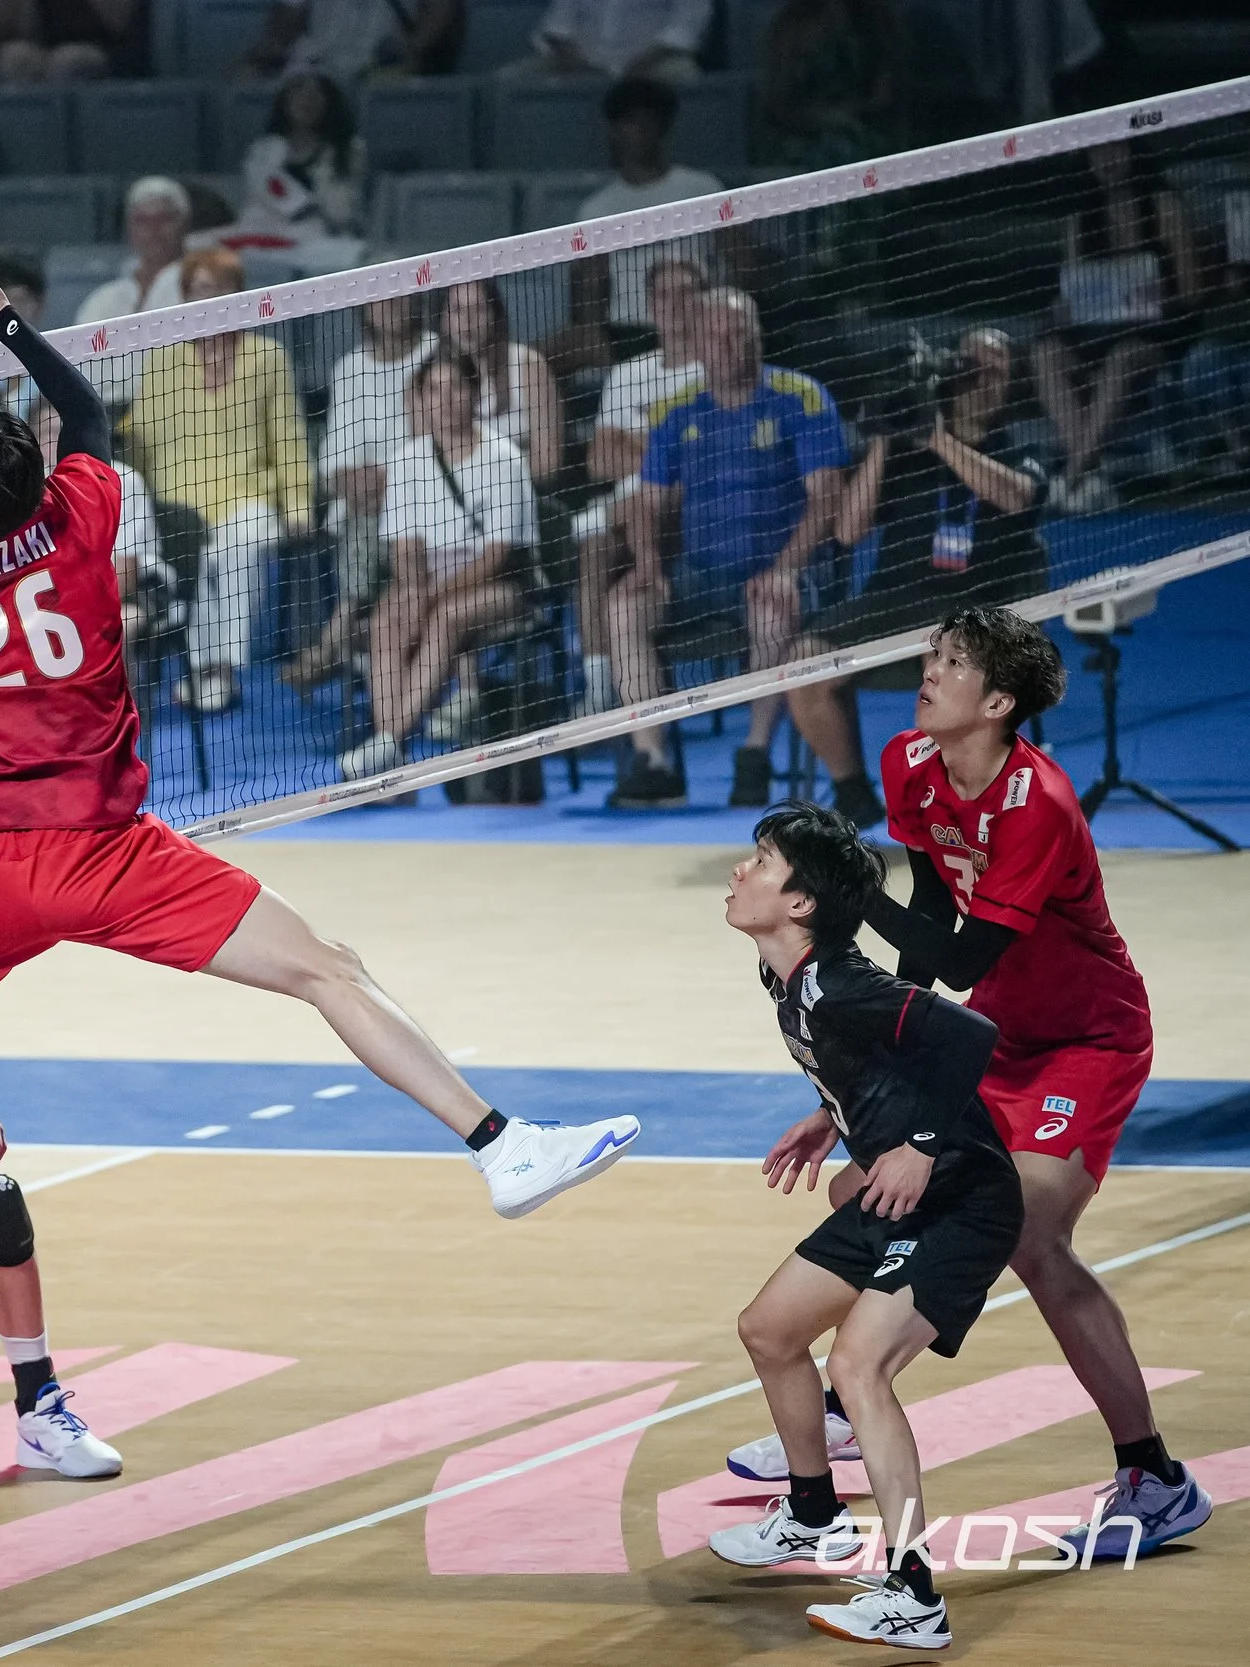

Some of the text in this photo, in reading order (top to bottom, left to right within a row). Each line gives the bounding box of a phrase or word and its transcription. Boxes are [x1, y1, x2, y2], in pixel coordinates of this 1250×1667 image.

[1010, 780, 1021, 806] POWER
[1046, 1097, 1073, 1114] TEL
[889, 1242, 911, 1252] TEL
